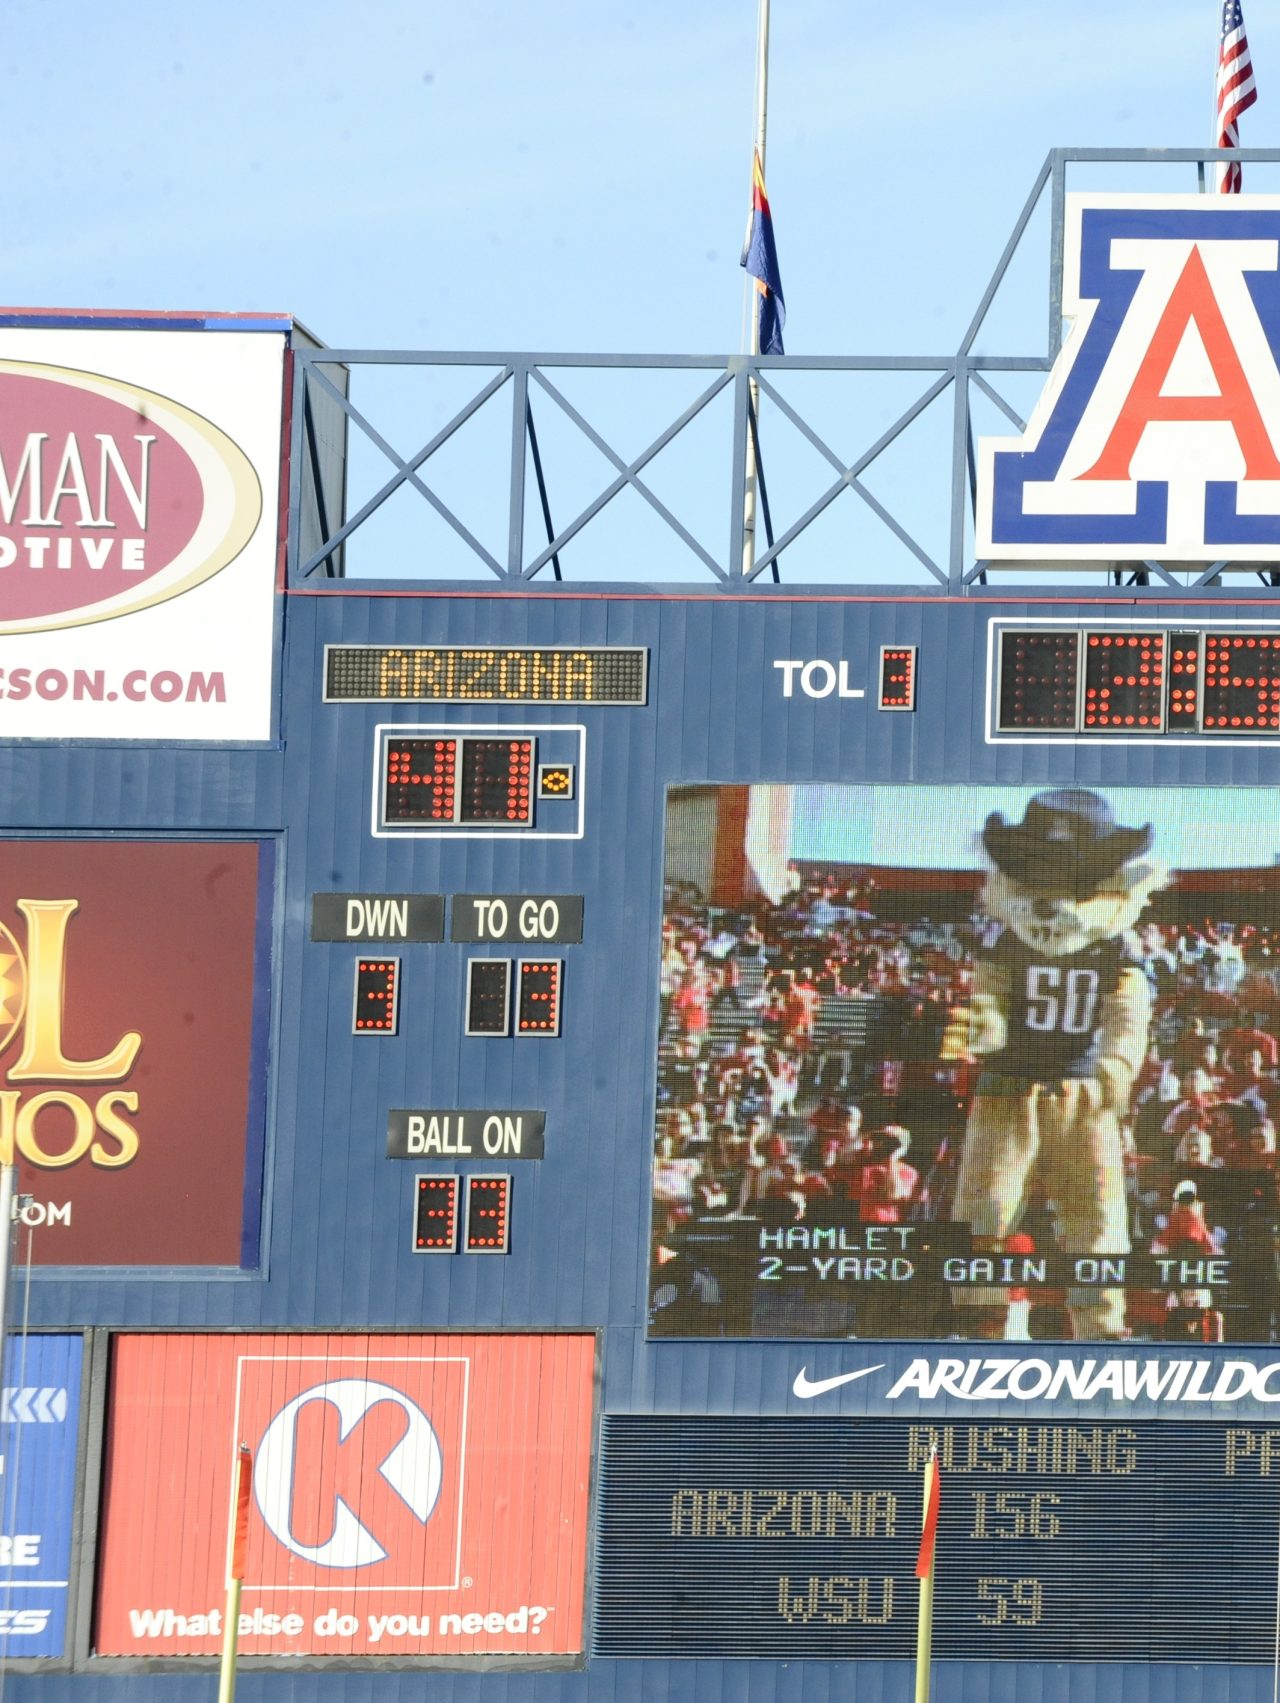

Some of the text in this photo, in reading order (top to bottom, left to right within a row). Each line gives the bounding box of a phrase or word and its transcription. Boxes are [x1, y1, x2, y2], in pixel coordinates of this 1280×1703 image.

[0, 668, 227, 703] SON.COM
[379, 649, 594, 699] ARIZONA
[774, 660, 864, 698] TOL
[883, 651, 914, 706] 3
[388, 741, 531, 819] 41
[346, 900, 408, 937] DWN
[474, 901, 559, 938] TO GO
[355, 963, 396, 1029] 3
[518, 964, 559, 1029] 3
[1025, 965, 1099, 1034] 50
[407, 1116, 521, 1154] BALL ON
[416, 1181, 507, 1245] 33
[758, 1256, 1231, 1285] 2-YARD GAIN ON THE
[908, 1427, 1137, 1474] RUSHING
[671, 1490, 897, 1537] ARIZONA
[970, 1493, 1061, 1539] 156
[130, 1606, 547, 1642] What else do you need?
[778, 1577, 893, 1624] WSU
[977, 1578, 1042, 1625] 59
